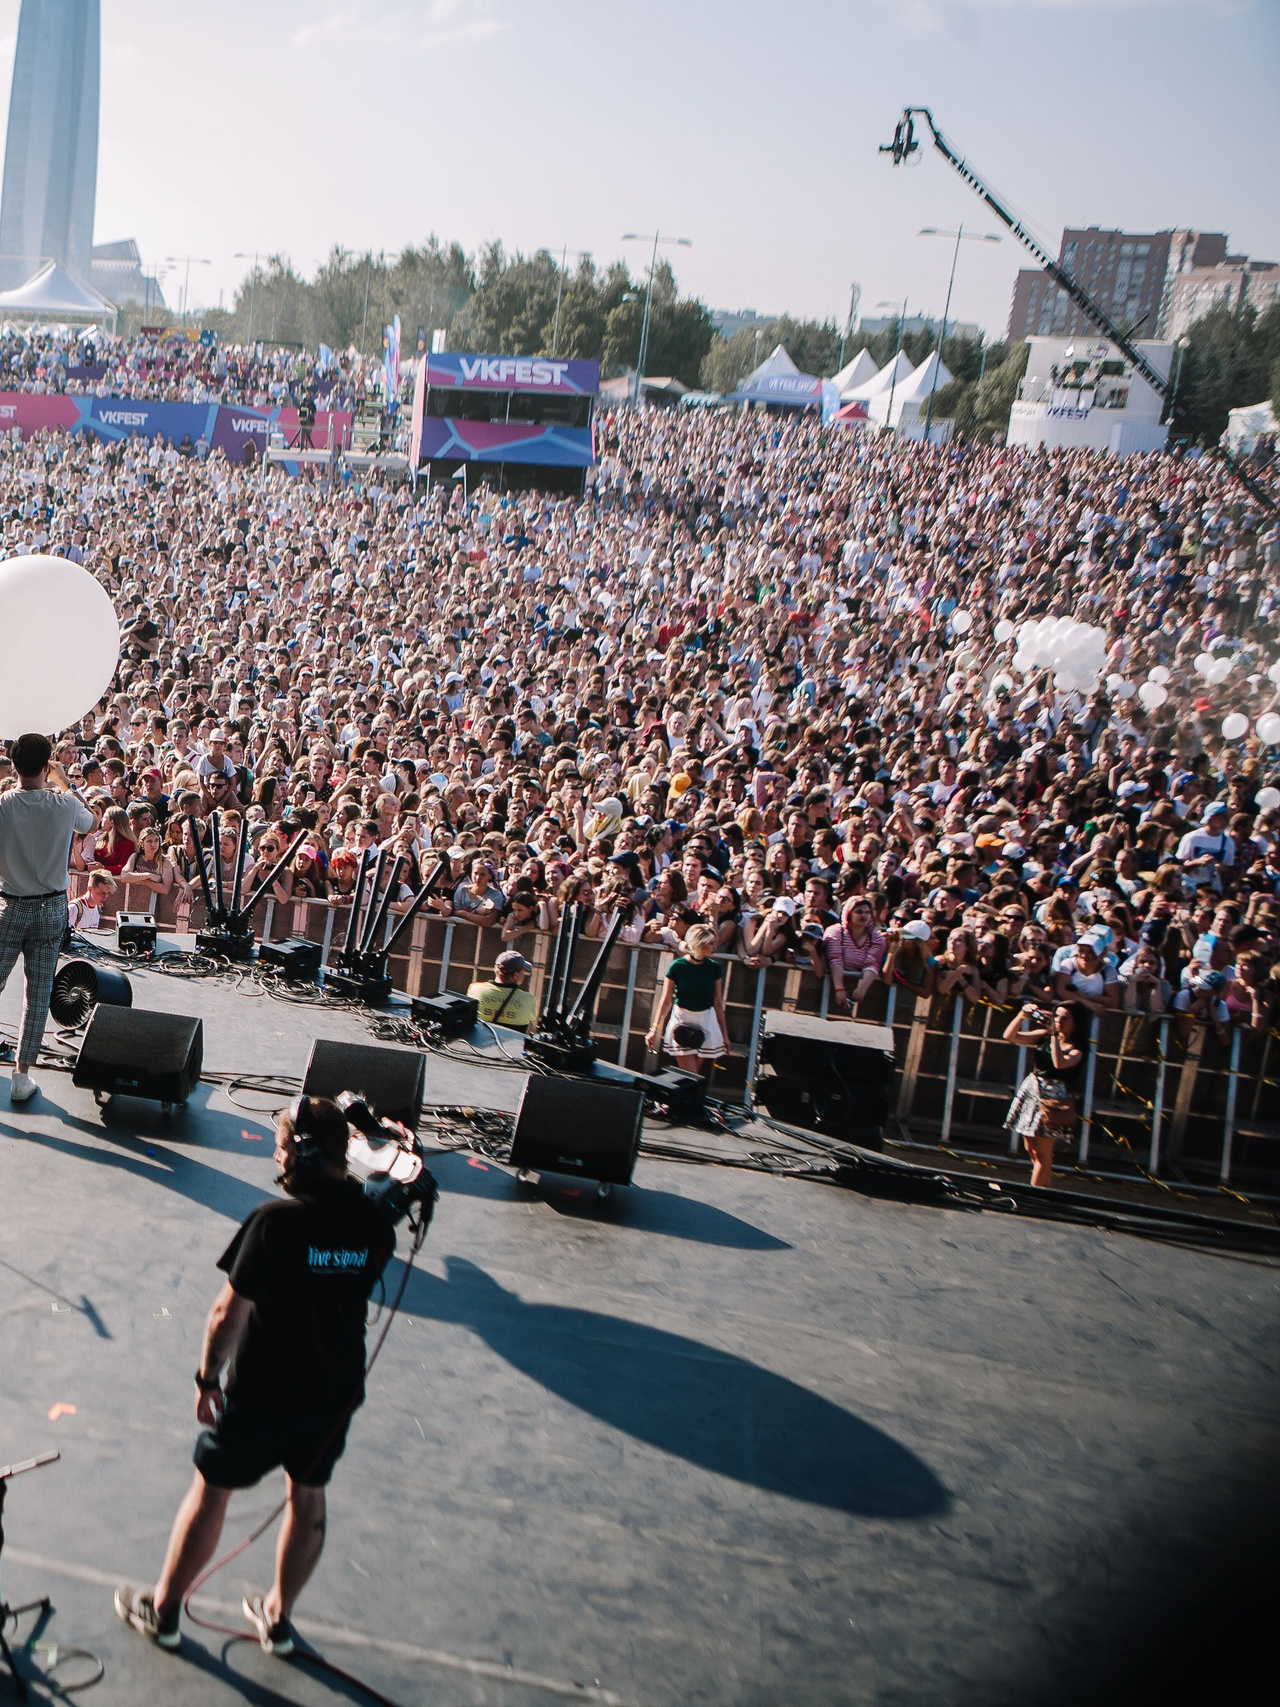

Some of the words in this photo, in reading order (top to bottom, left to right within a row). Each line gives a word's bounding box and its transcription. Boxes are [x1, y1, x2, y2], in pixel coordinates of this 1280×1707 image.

[459, 357, 568, 386] VKFEST
[99, 410, 148, 426] VKFEST
[309, 1246, 331, 1266] live
